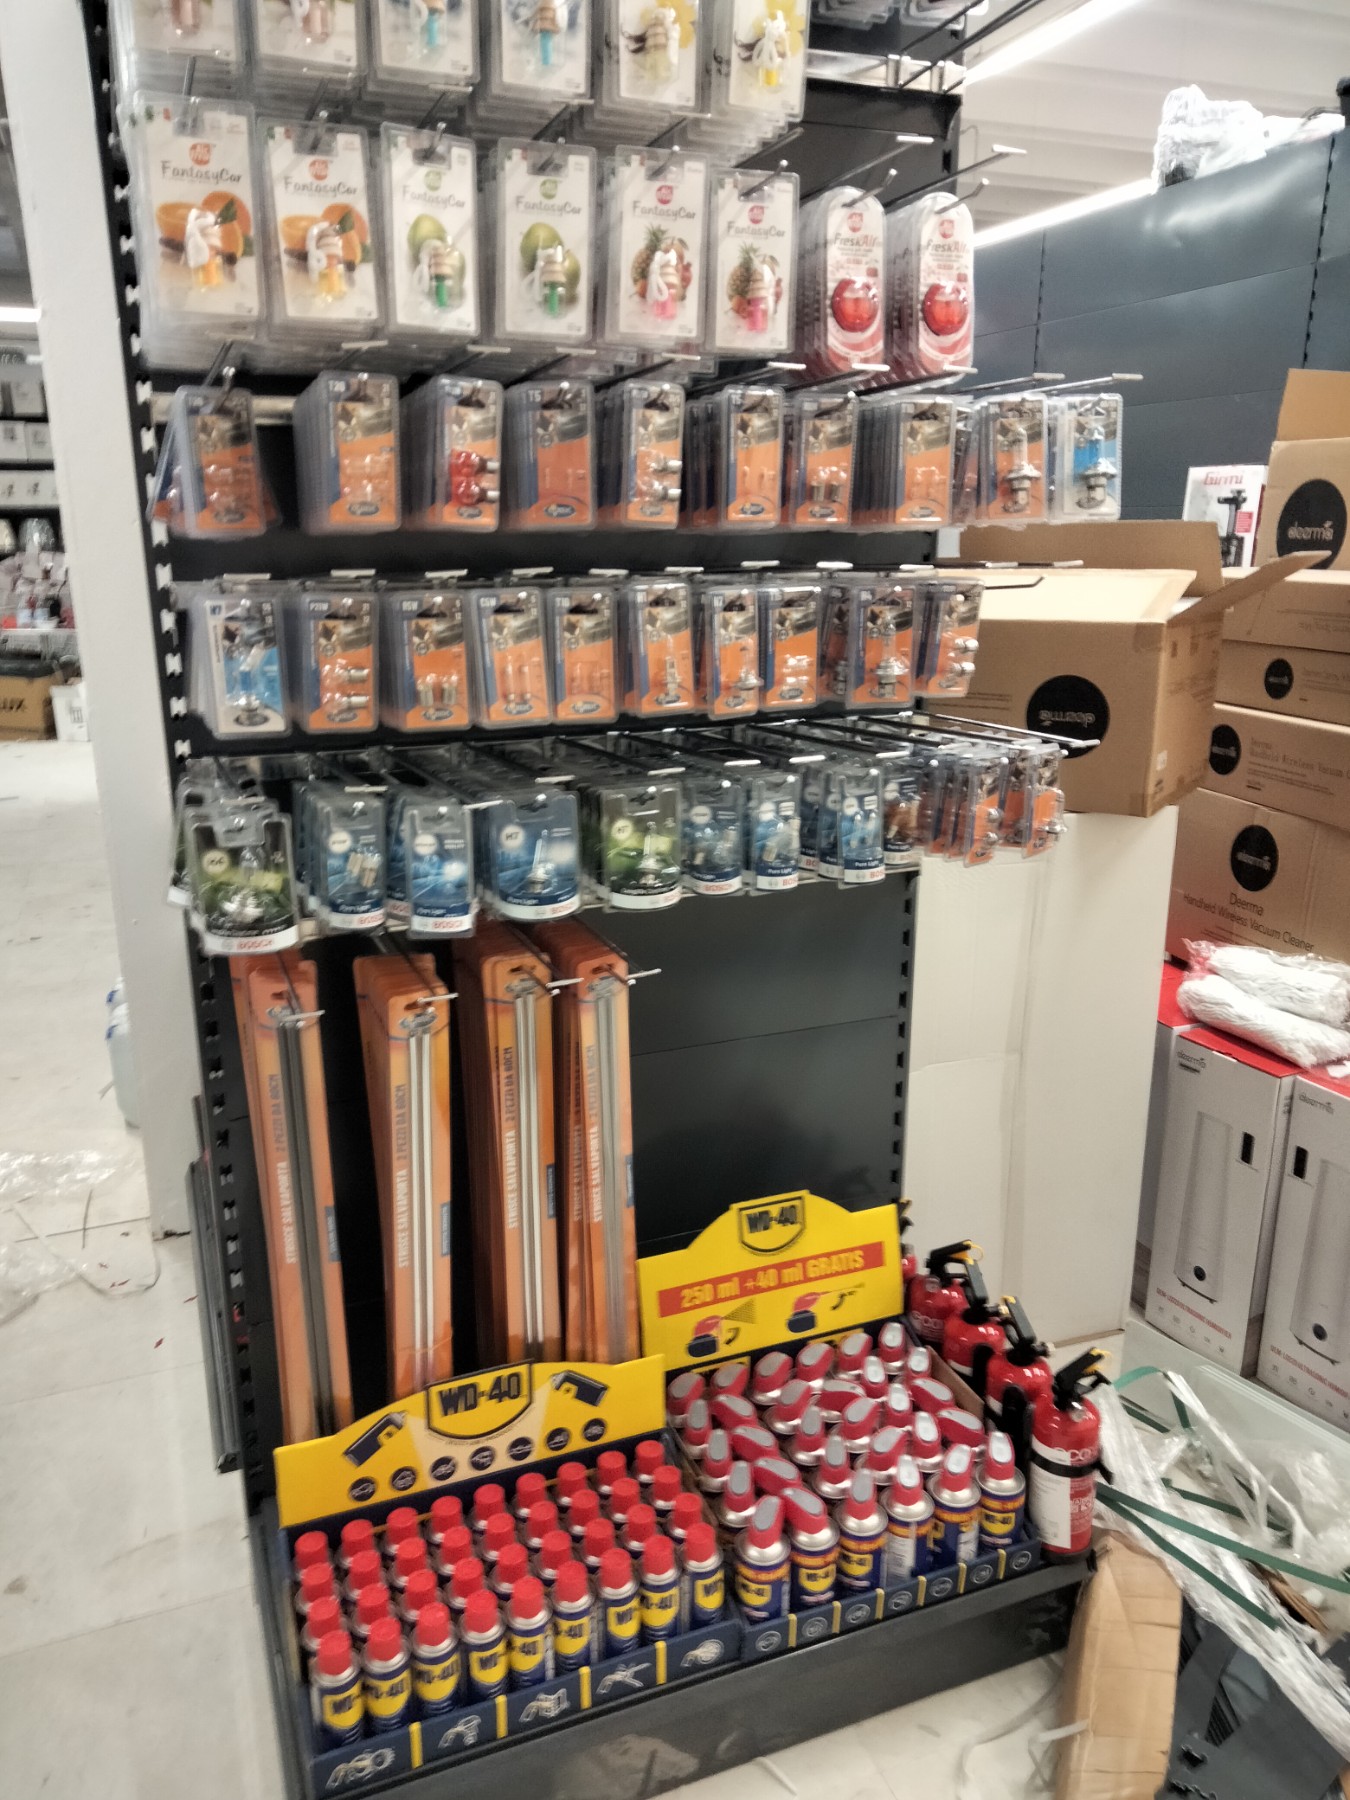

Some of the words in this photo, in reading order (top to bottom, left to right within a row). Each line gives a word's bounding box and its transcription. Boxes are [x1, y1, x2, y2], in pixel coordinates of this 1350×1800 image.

[161, 160, 243, 184] FantasyCar
[283, 176, 358, 197] FantasyCar
[402, 185, 466, 209] FantasyCar
[515, 195, 582, 216] FantasyCar
[632, 201, 696, 221] FantasyCar
[727, 221, 786, 239] FantasyCar
[1287, 520, 1334, 542] deerma
[1230, 892, 1264, 916] Deerma
[1217, 906, 1248, 927] Wireless
[1250, 917, 1281, 939] Vacuum
[1283, 931, 1315, 952] Cleaner
[504, 1074, 514, 1087] DA
[505, 1129, 517, 1190] SALVAPORTA
[746, 1204, 799, 1234] WD-40
[680, 1282, 714, 1309] 250
[717, 1277, 740, 1299] ml
[781, 1263, 804, 1284] ml
[806, 1250, 865, 1279] GRATIS
[438, 1371, 522, 1417] WD-40
